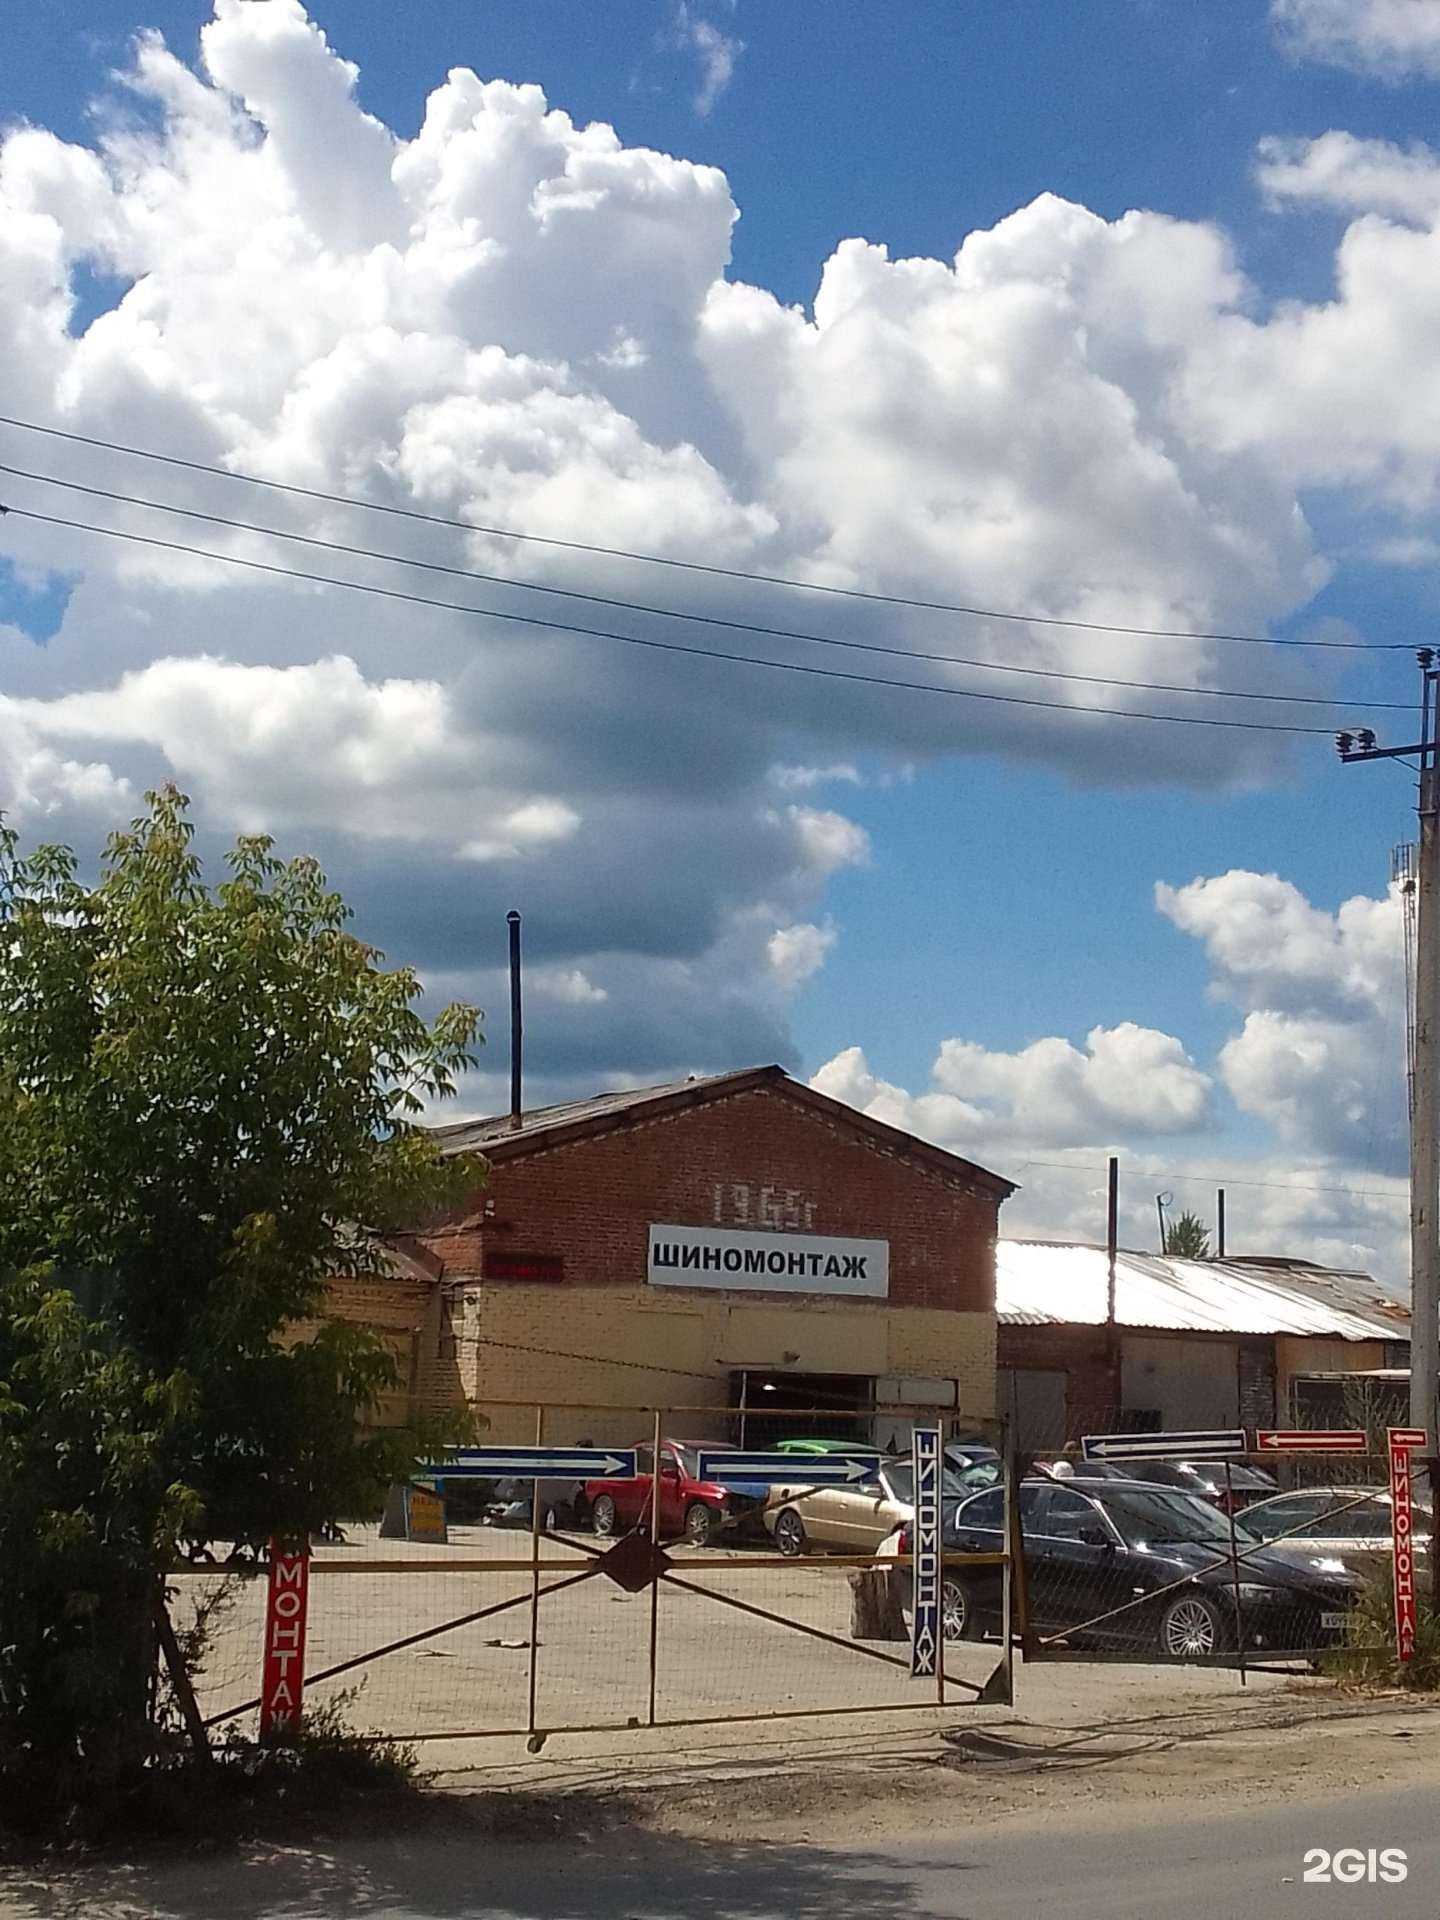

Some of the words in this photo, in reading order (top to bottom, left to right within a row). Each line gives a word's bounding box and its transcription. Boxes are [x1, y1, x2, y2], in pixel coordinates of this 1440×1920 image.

[652, 1242, 867, 1279] ШИНОМОНТАЖ
[269, 1534, 303, 1732] МОНТАЖ
[914, 1434, 938, 1674] ШИНОМОНТАЖ
[1393, 1451, 1415, 1654] ШИНОМОНТАЖ
